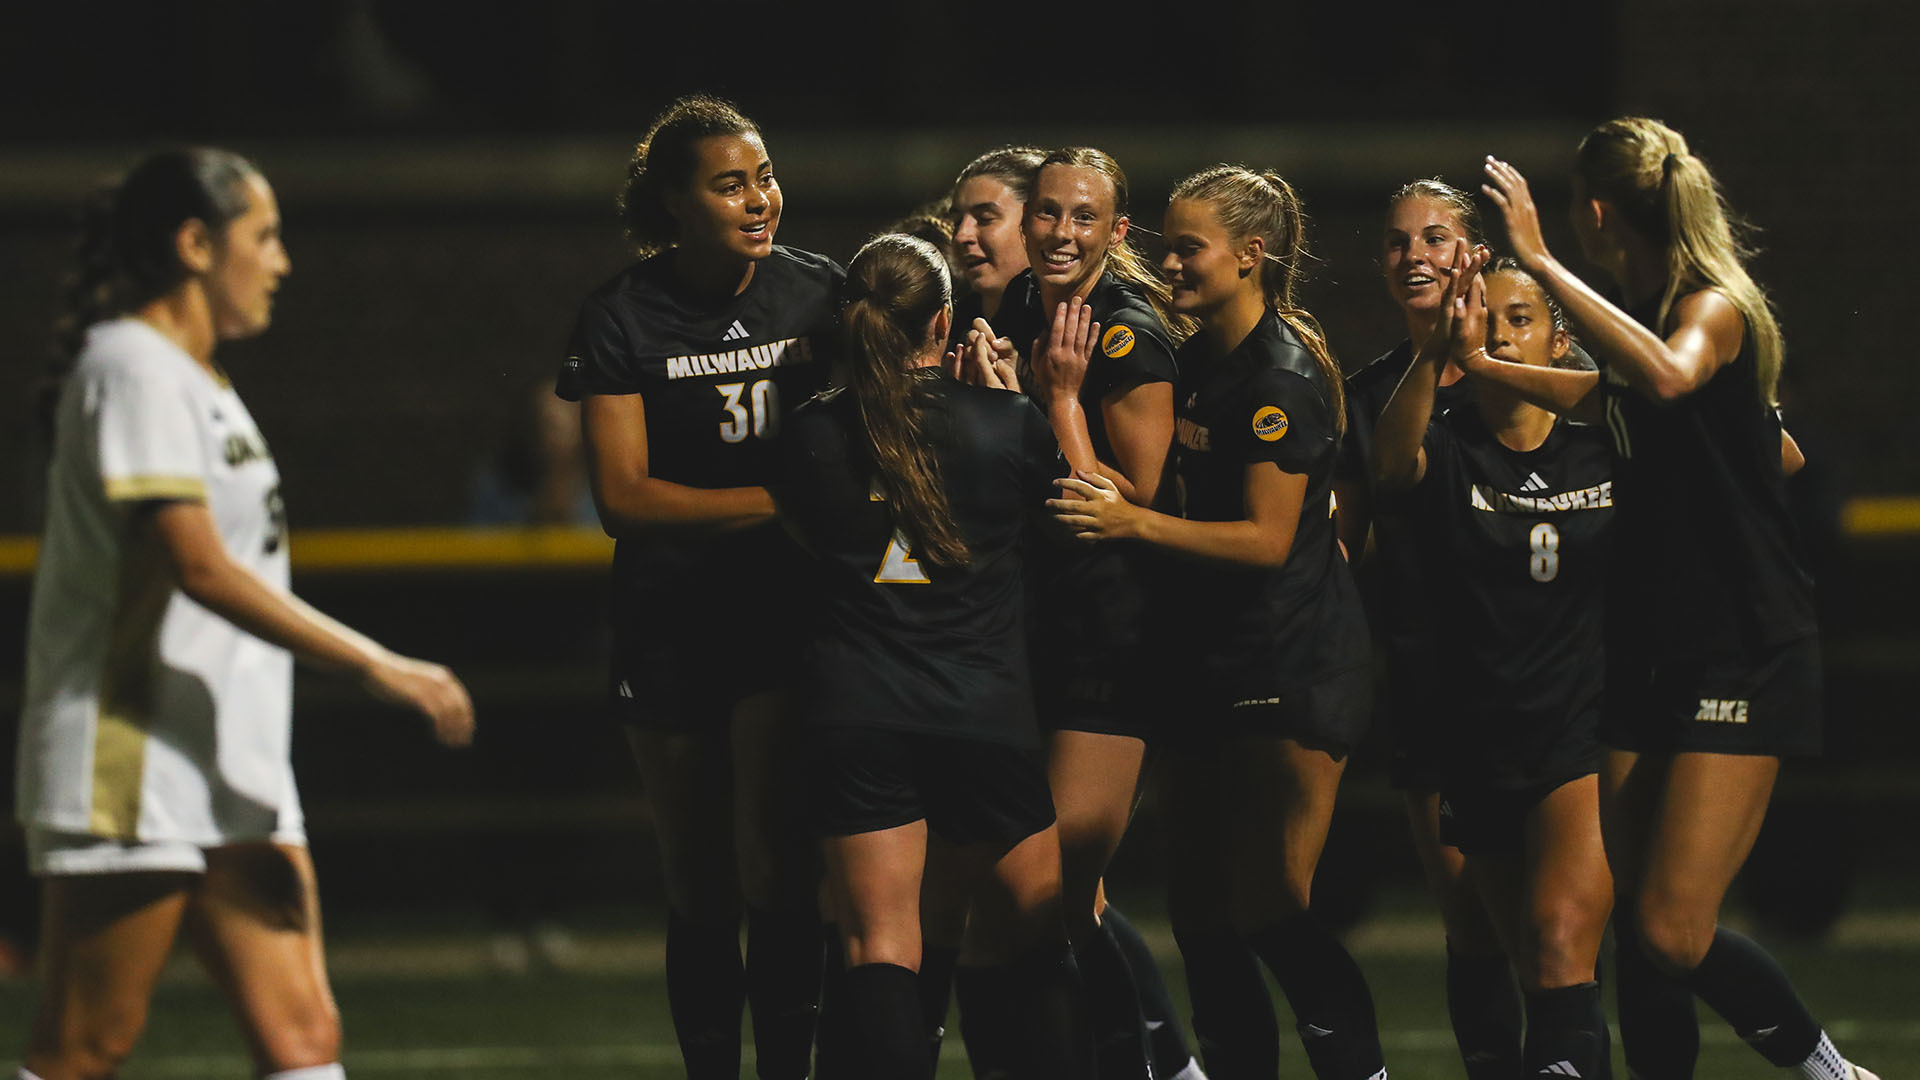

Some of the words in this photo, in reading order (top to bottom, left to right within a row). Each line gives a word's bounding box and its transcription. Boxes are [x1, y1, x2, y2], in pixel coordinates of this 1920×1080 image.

[715, 379, 780, 443] 30
[1471, 481, 1613, 512] MILWAUKEE
[1529, 522, 1559, 583] 8
[1694, 698, 1749, 723] MKE
